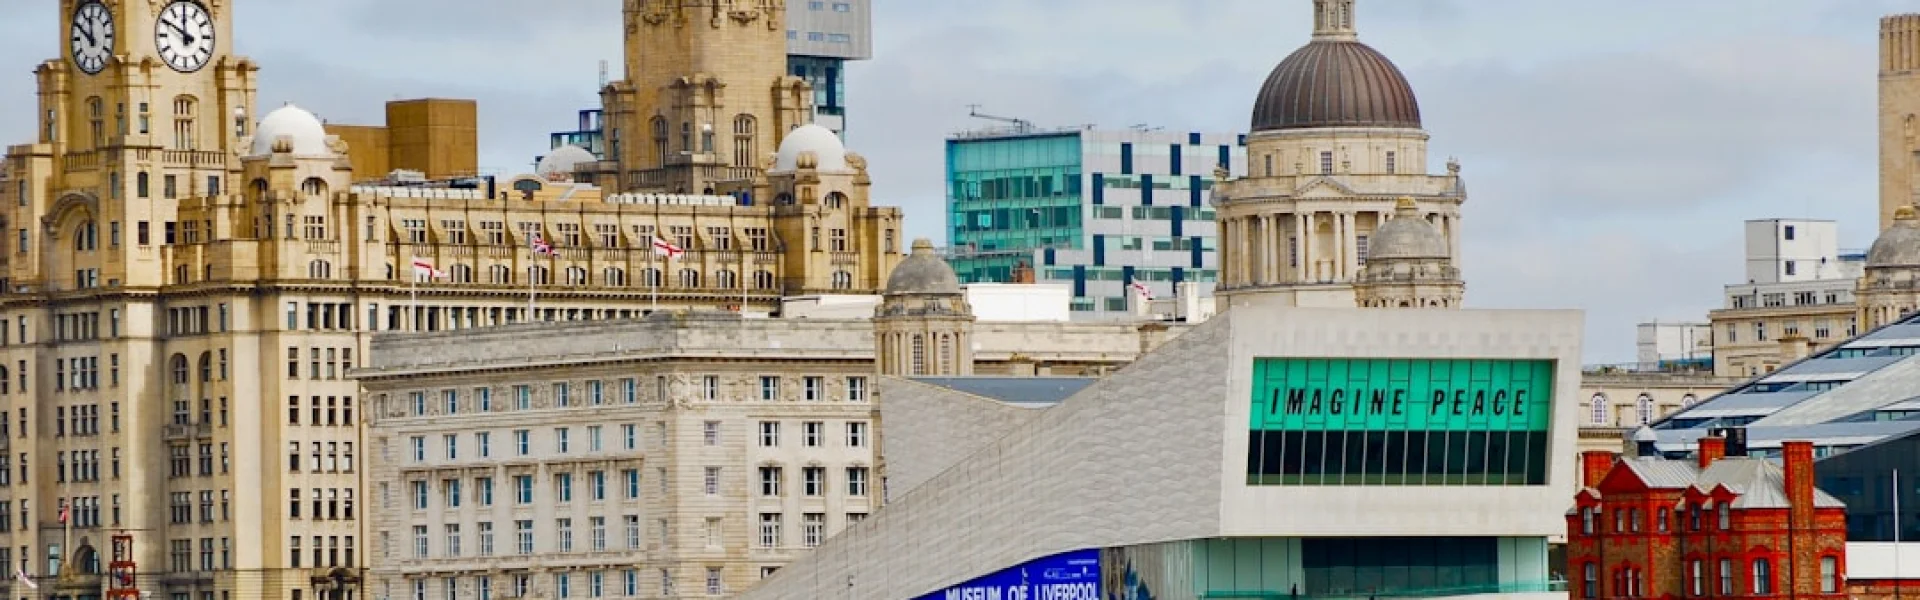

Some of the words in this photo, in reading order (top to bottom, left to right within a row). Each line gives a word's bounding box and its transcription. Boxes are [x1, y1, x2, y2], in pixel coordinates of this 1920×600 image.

[1271, 388, 1405, 415] IMAGINE
[1431, 389, 1526, 415] PEACE
[945, 586, 1001, 600] MUSEUM
[1008, 585, 1028, 600] OF
[1034, 582, 1099, 600] LIVERPOOL
